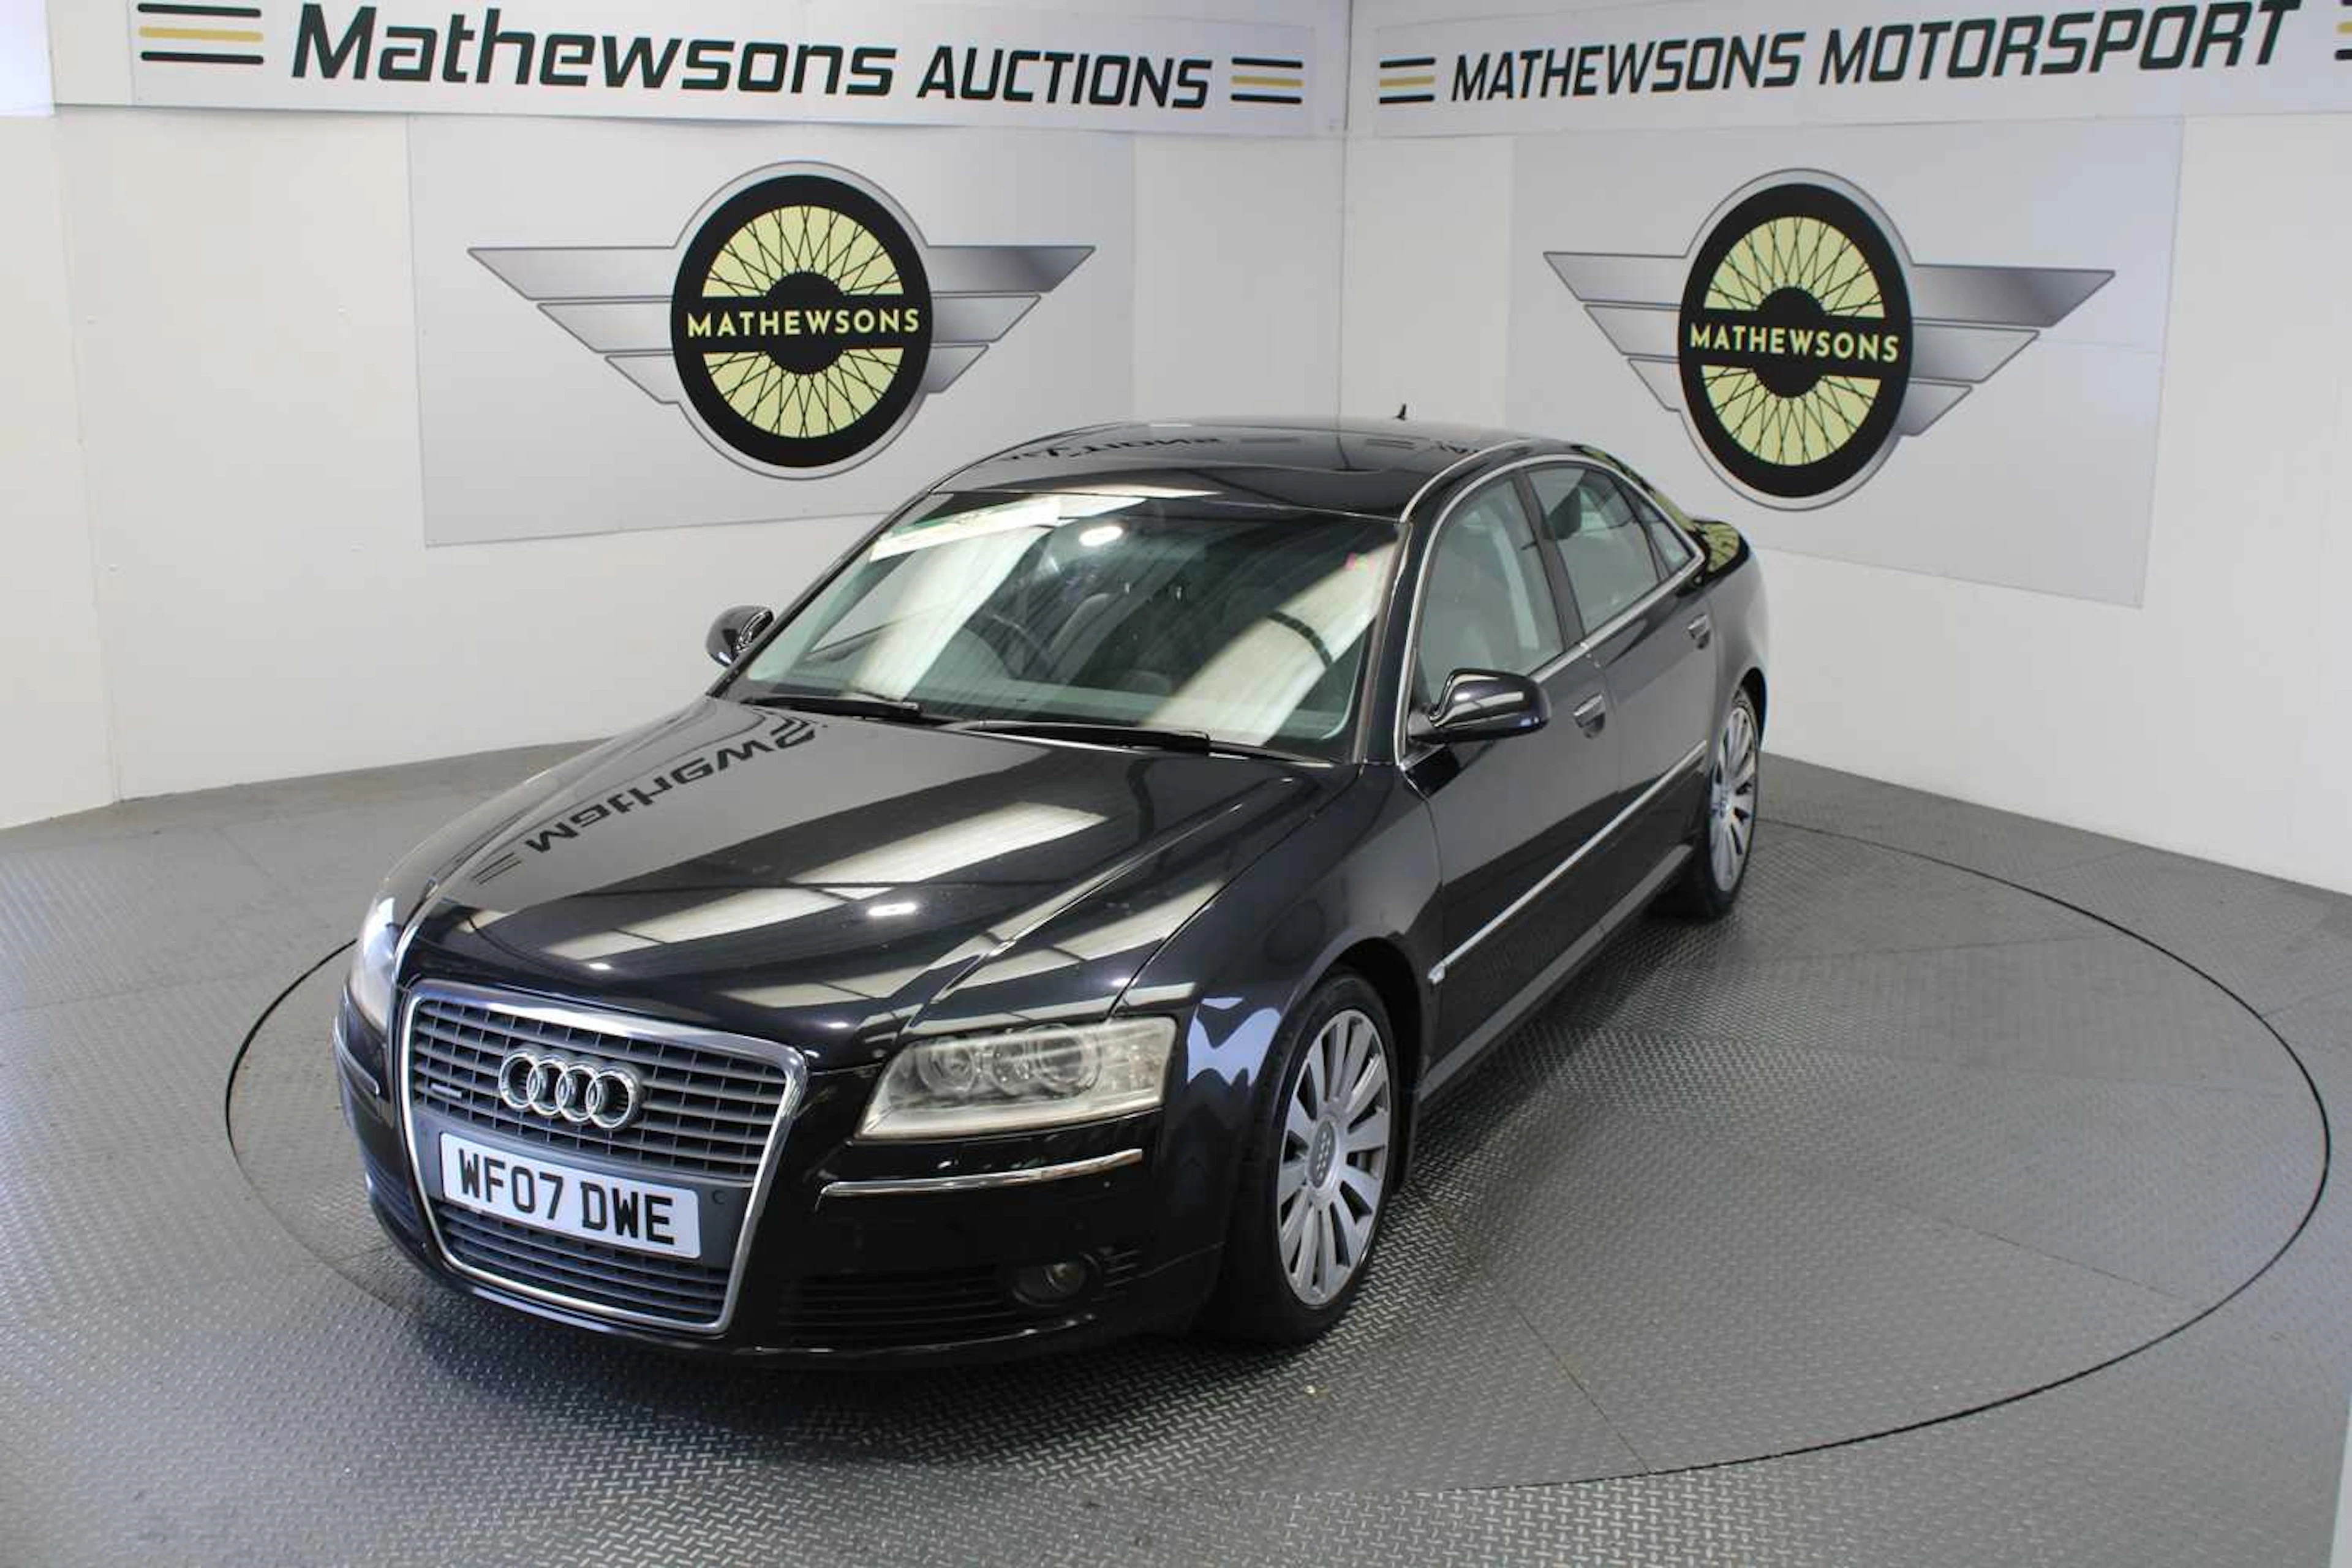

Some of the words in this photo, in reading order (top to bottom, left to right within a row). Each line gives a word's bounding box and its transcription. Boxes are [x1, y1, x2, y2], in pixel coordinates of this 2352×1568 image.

[292, 3, 897, 96] Mathewsons
[916, 46, 1213, 110] AUCTIONS
[1451, 32, 1806, 102] MATHEWSONS
[1819, 0, 2302, 85] MOTORSPORT
[687, 308, 919, 337] MATHEWSONS
[1691, 323, 1899, 363] MATHEWSONS
[458, 1148, 564, 1220] WF07
[580, 1180, 674, 1246] DWE
